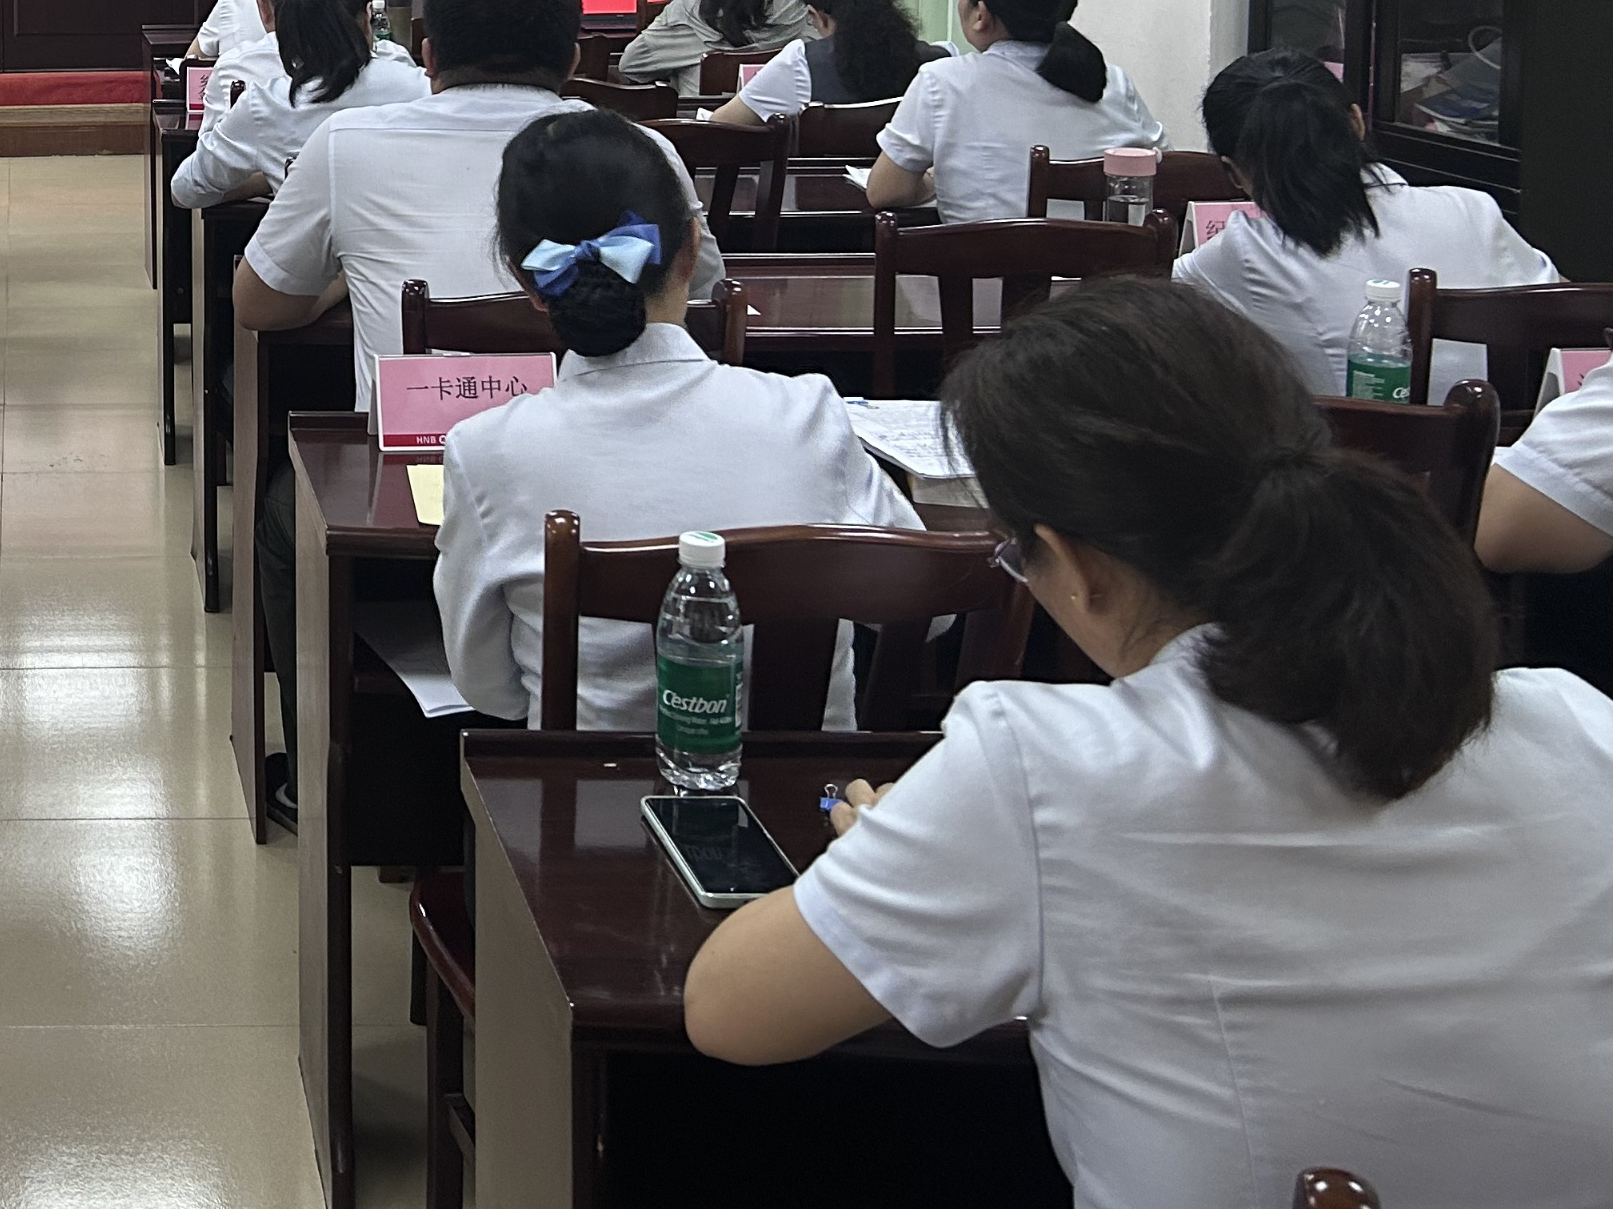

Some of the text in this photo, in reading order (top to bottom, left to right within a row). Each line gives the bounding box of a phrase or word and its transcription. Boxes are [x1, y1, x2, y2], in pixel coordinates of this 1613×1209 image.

[406, 375, 528, 401] 一卡通中心
[416, 435, 437, 445] HNB
[662, 689, 727, 714] Cestbon
